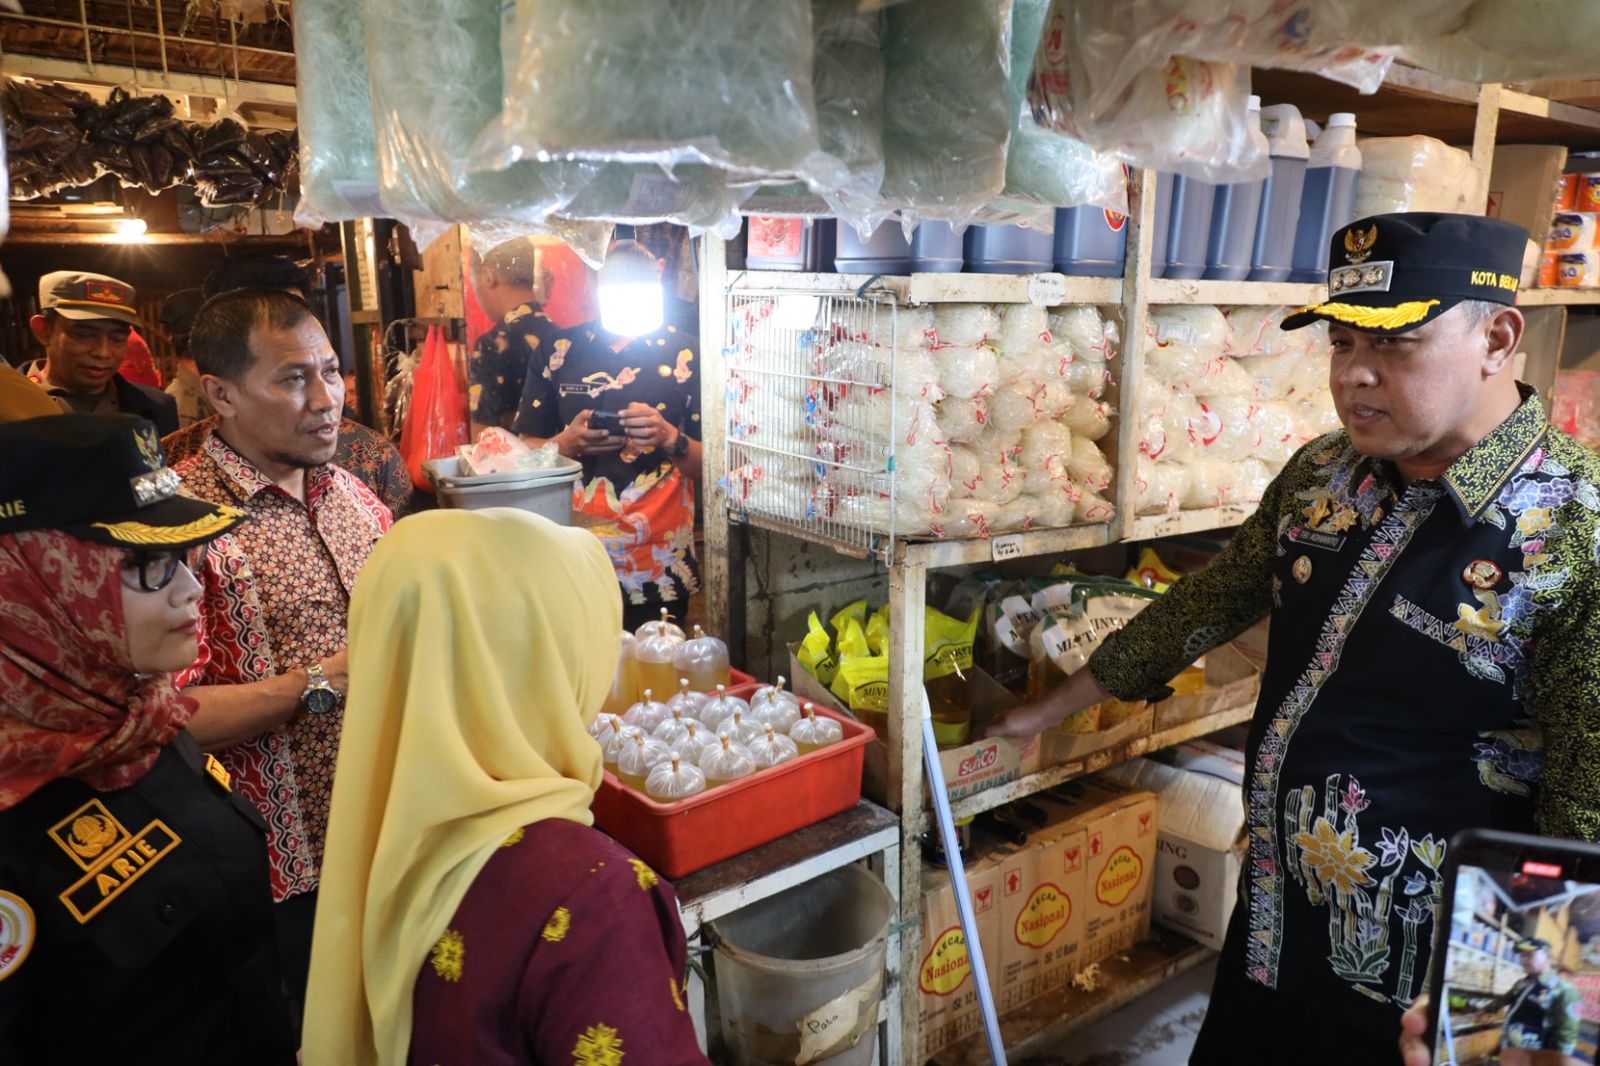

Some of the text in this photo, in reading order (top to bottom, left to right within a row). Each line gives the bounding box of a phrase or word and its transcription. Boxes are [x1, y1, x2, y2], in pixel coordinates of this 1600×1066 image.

[1471, 270, 1497, 287] KOTA
[960, 748, 996, 776] SunCo
[96, 839, 157, 897] ARIE
[1101, 866, 1137, 895] Nasional
[1031, 892, 1057, 912] KECAP
[1021, 905, 1065, 935] Nasional
